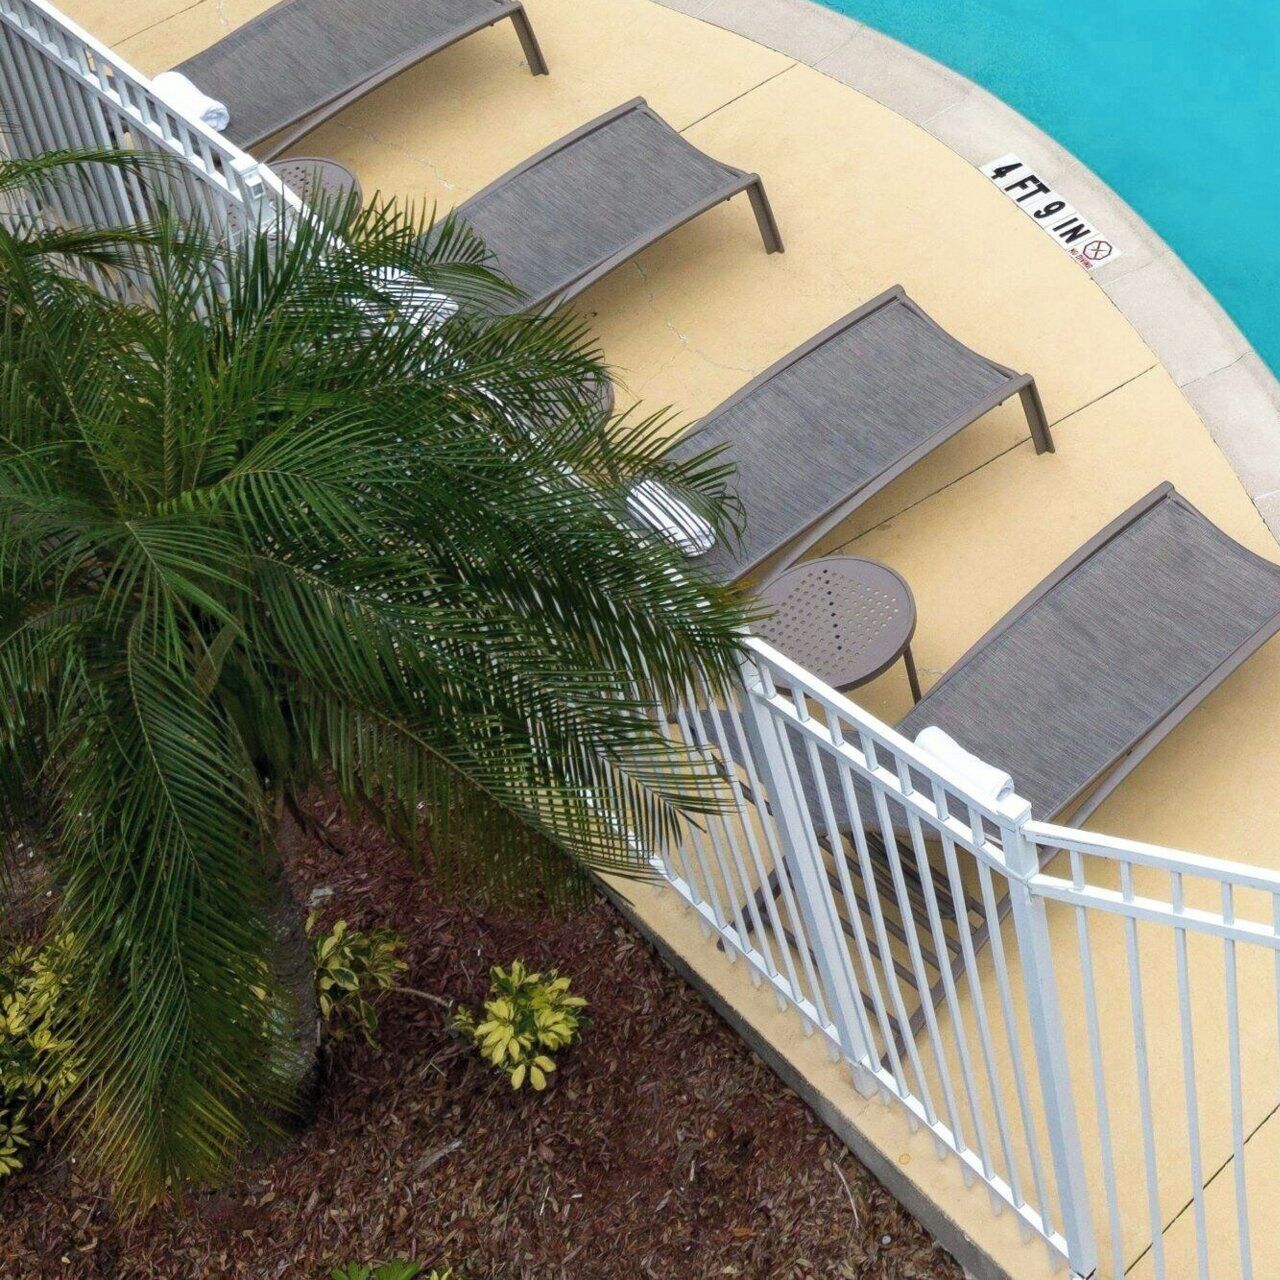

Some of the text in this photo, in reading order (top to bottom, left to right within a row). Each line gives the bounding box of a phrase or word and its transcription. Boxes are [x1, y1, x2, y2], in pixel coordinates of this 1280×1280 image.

[991, 162, 1091, 244] 4 FT 9 IN
